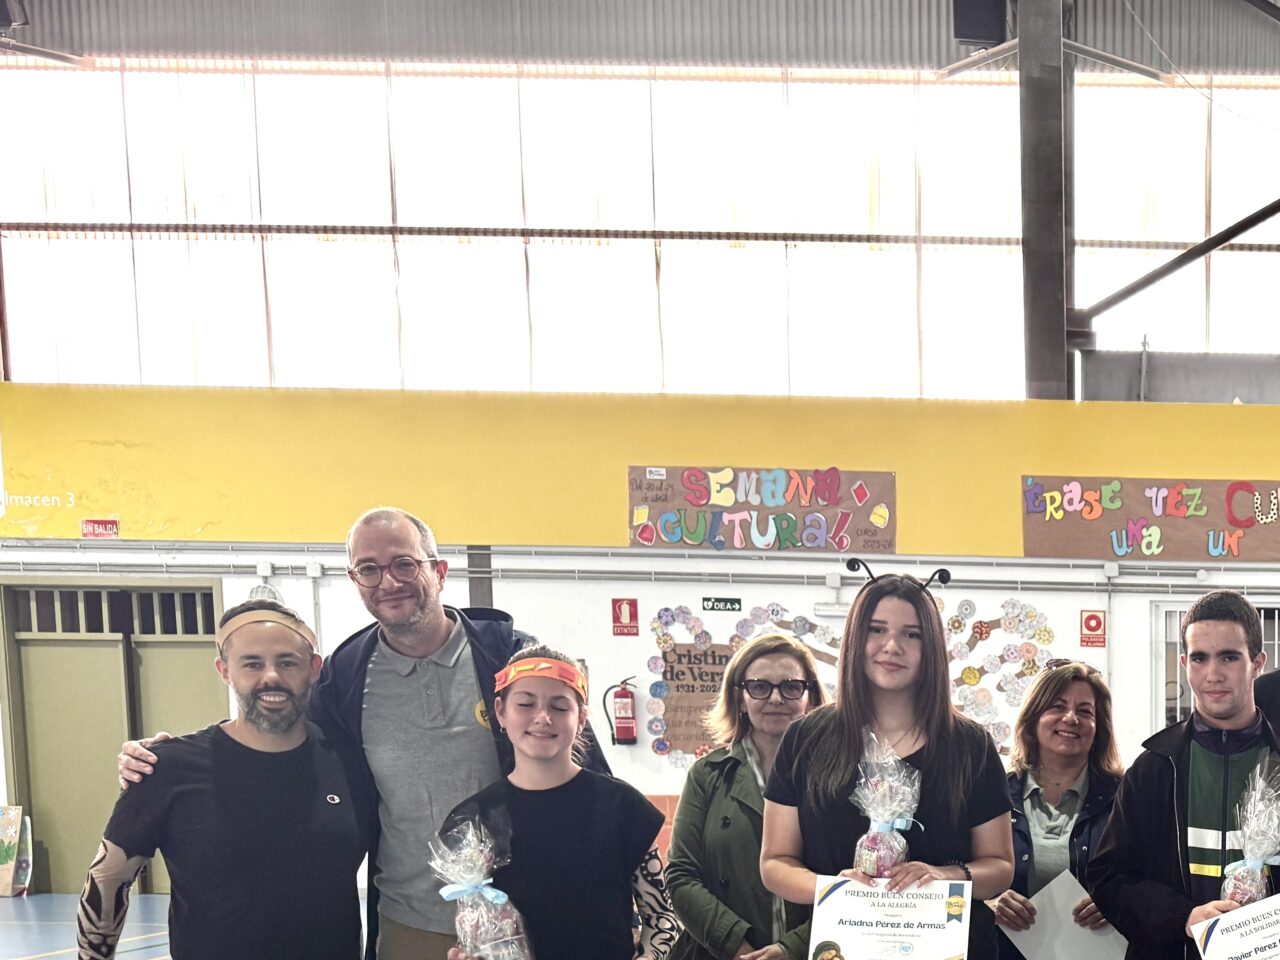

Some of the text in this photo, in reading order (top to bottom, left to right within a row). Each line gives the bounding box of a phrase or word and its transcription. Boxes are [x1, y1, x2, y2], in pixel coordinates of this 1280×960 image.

[681, 467, 841, 507] SEMANA
[66, 491, 75, 507] 3
[1144, 482, 1208, 518] VEZ
[83, 524, 117, 534] SIN SALIDA
[657, 509, 852, 551] CULTURAL
[662, 649, 732, 665] Cristin
[662, 666, 685, 681] de
[845, 890, 880, 898] PREMIO
[838, 918, 874, 927] Ariadna
[876, 920, 901, 928] Pérez
[1221, 919, 1251, 935] PREMIO
[1252, 911, 1274, 924] BUEN
[1254, 942, 1278, 954] Pérez
